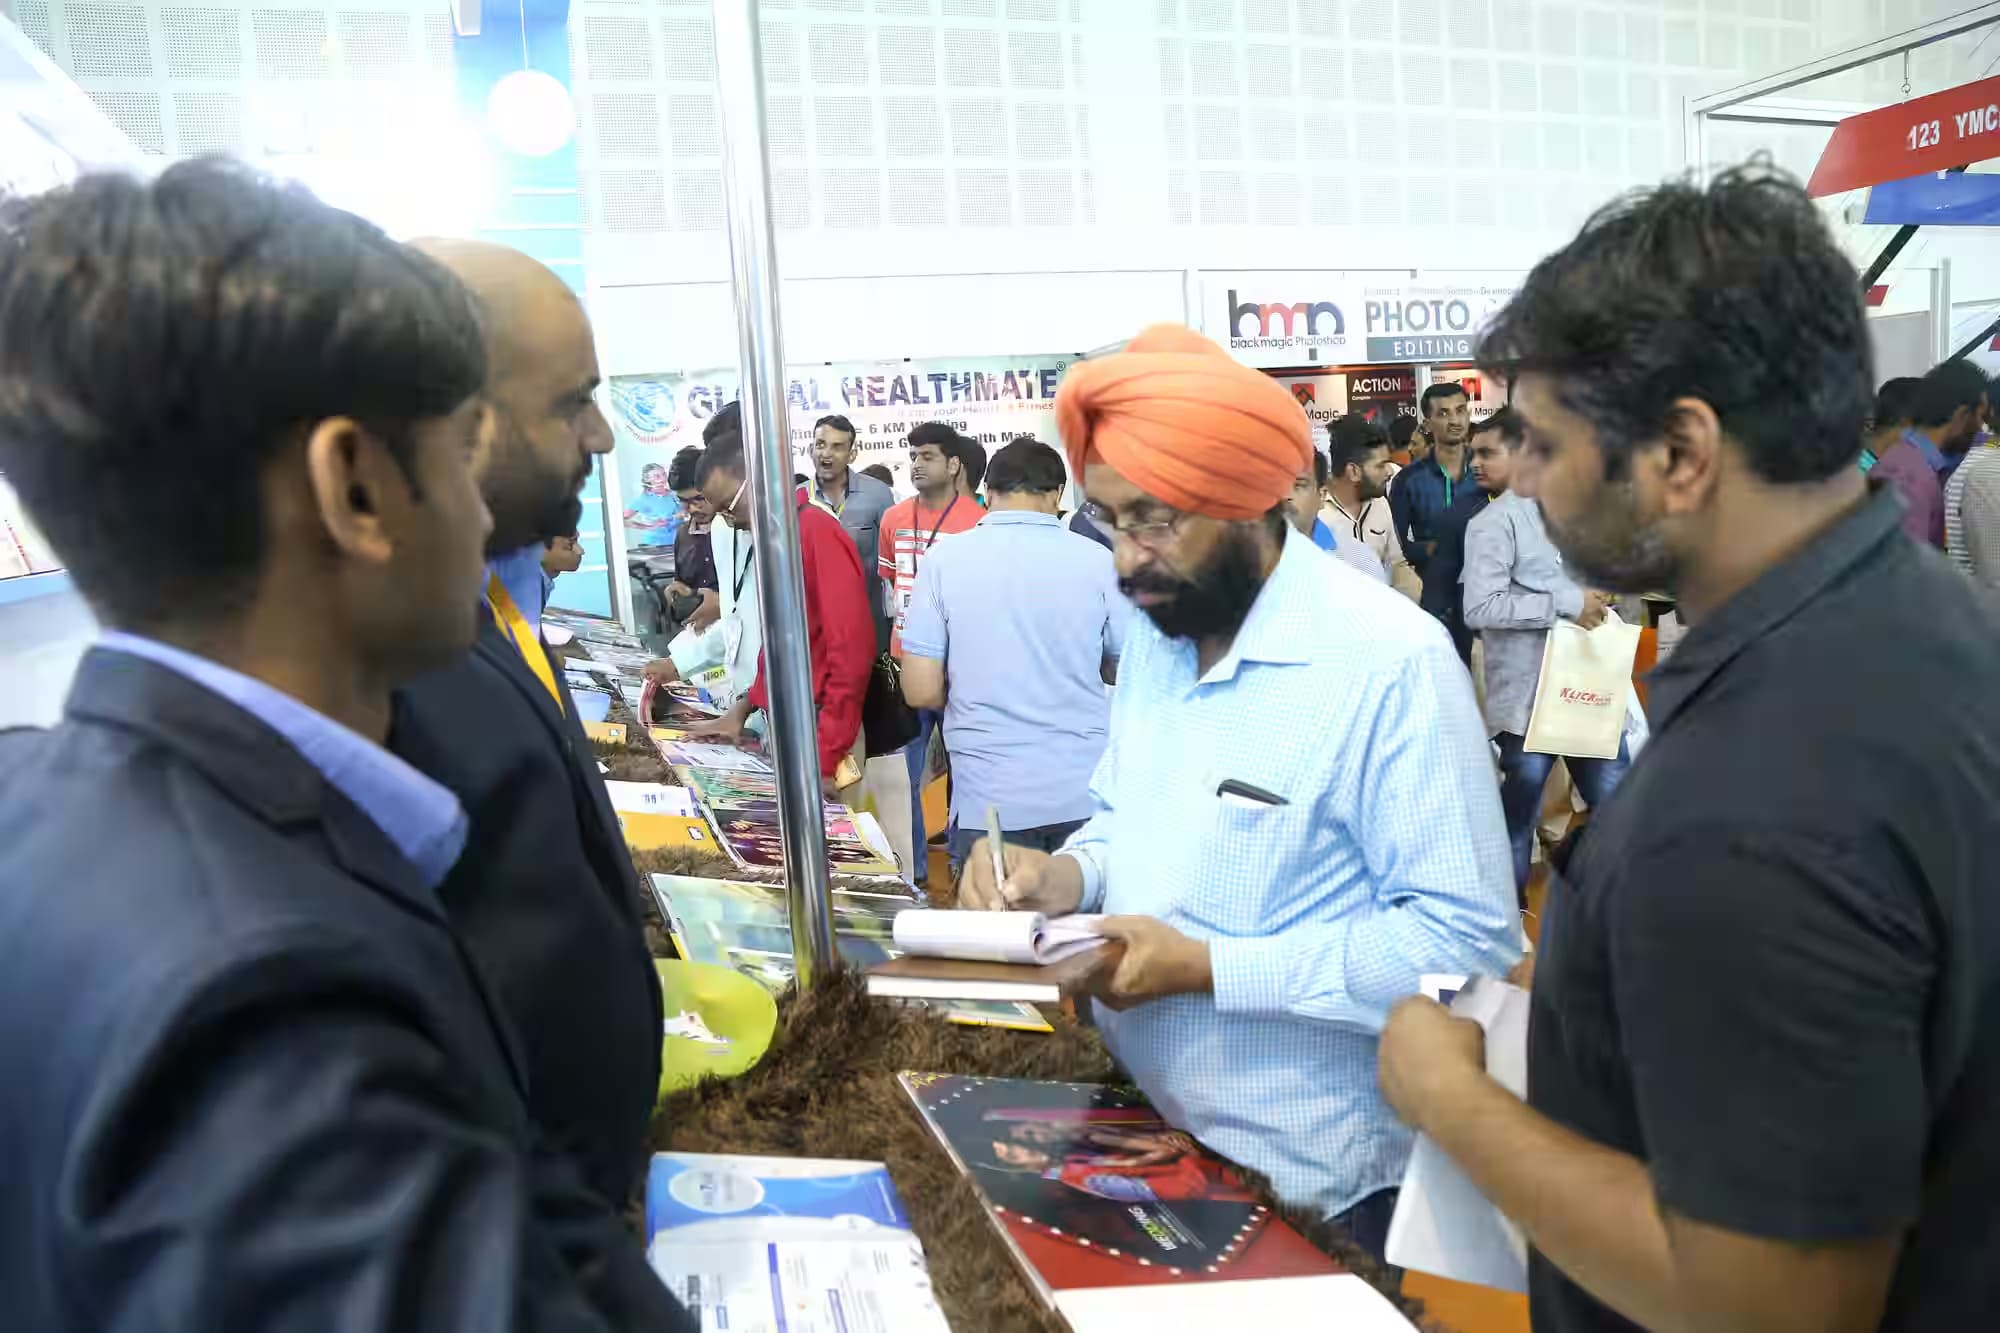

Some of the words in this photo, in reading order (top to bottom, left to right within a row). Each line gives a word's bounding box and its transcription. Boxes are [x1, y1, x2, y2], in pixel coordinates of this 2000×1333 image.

[1906, 119, 1940, 150] 123
[1953, 103, 2000, 139] YMC
[1365, 300, 1471, 333] PHOTO
[1393, 339, 1470, 357] EDITING
[840, 368, 1057, 409] HEALTHMATE
[1352, 376, 1401, 393] ACTION
[1305, 408, 1340, 422] Magic
[868, 423, 878, 434] 6
[883, 422, 906, 433] KM
